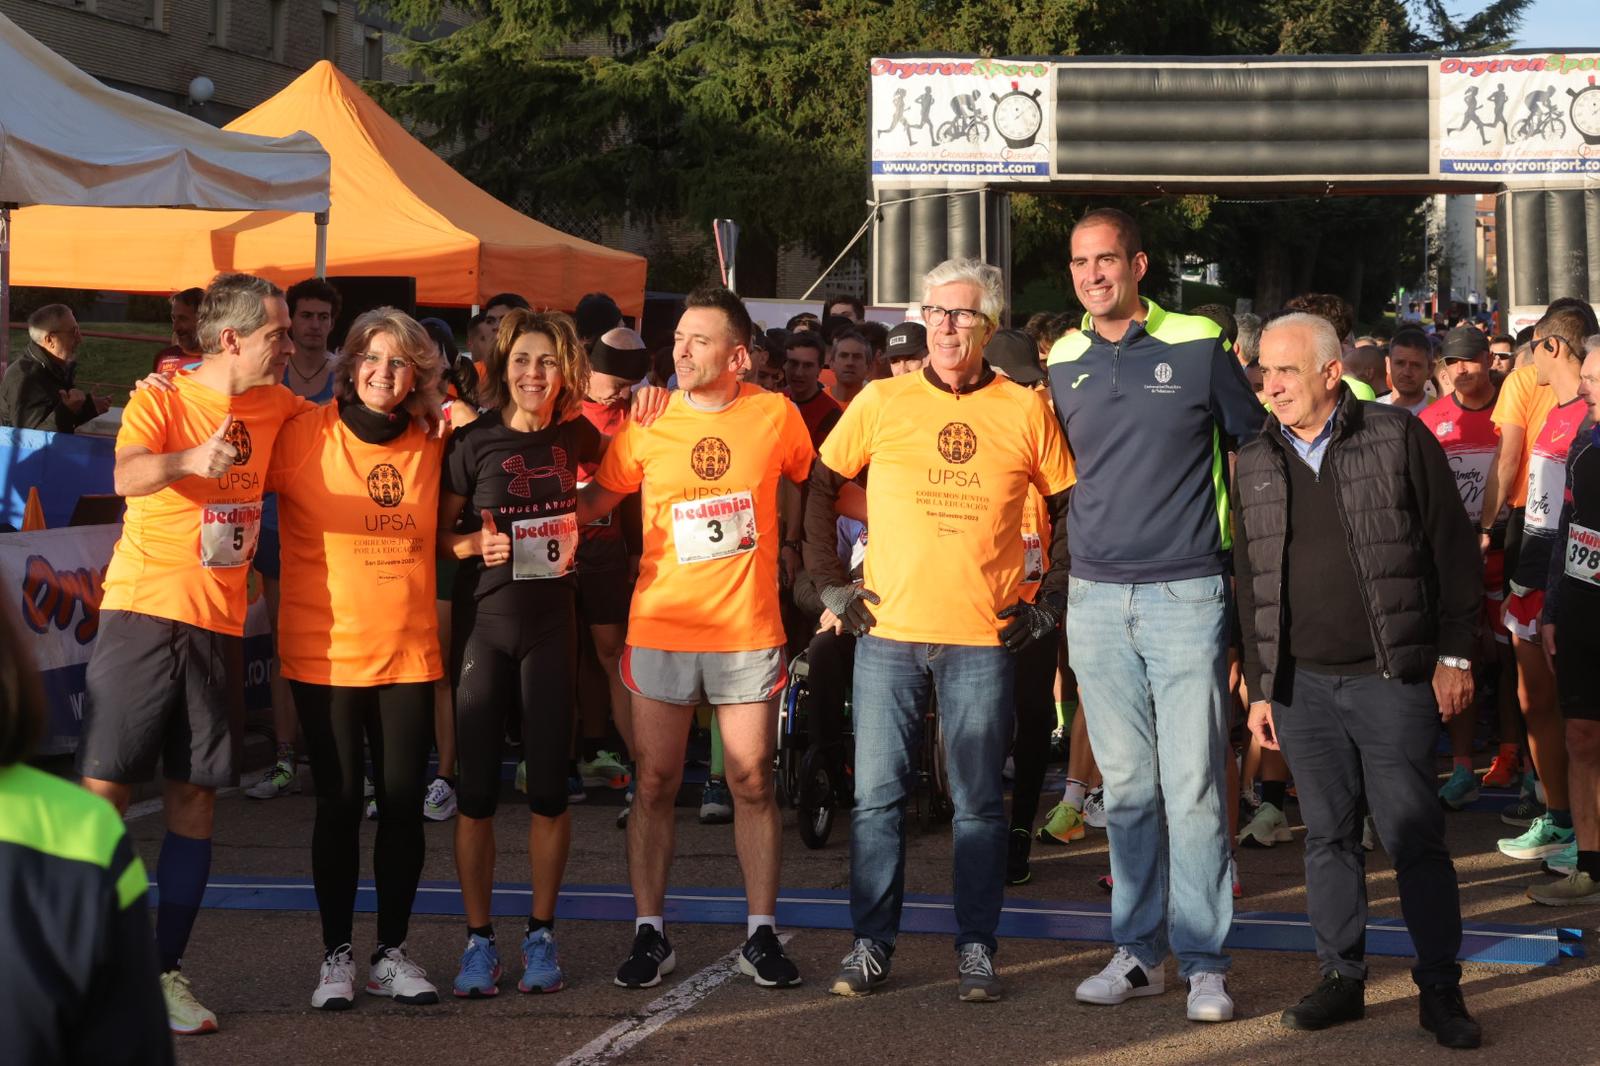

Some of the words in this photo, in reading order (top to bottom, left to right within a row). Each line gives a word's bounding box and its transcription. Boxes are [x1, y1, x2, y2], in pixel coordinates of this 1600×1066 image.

[882, 162, 1036, 175] www.orycronsport.com
[928, 468, 981, 488] UPSA
[916, 490, 959, 500] CORREMOS
[961, 493, 990, 502] JUNTOS
[500, 504, 539, 514] UNDER
[364, 513, 417, 532] UPSA
[707, 520, 724, 543] 3
[232, 527, 245, 551] 5
[546, 538, 560, 563] 8
